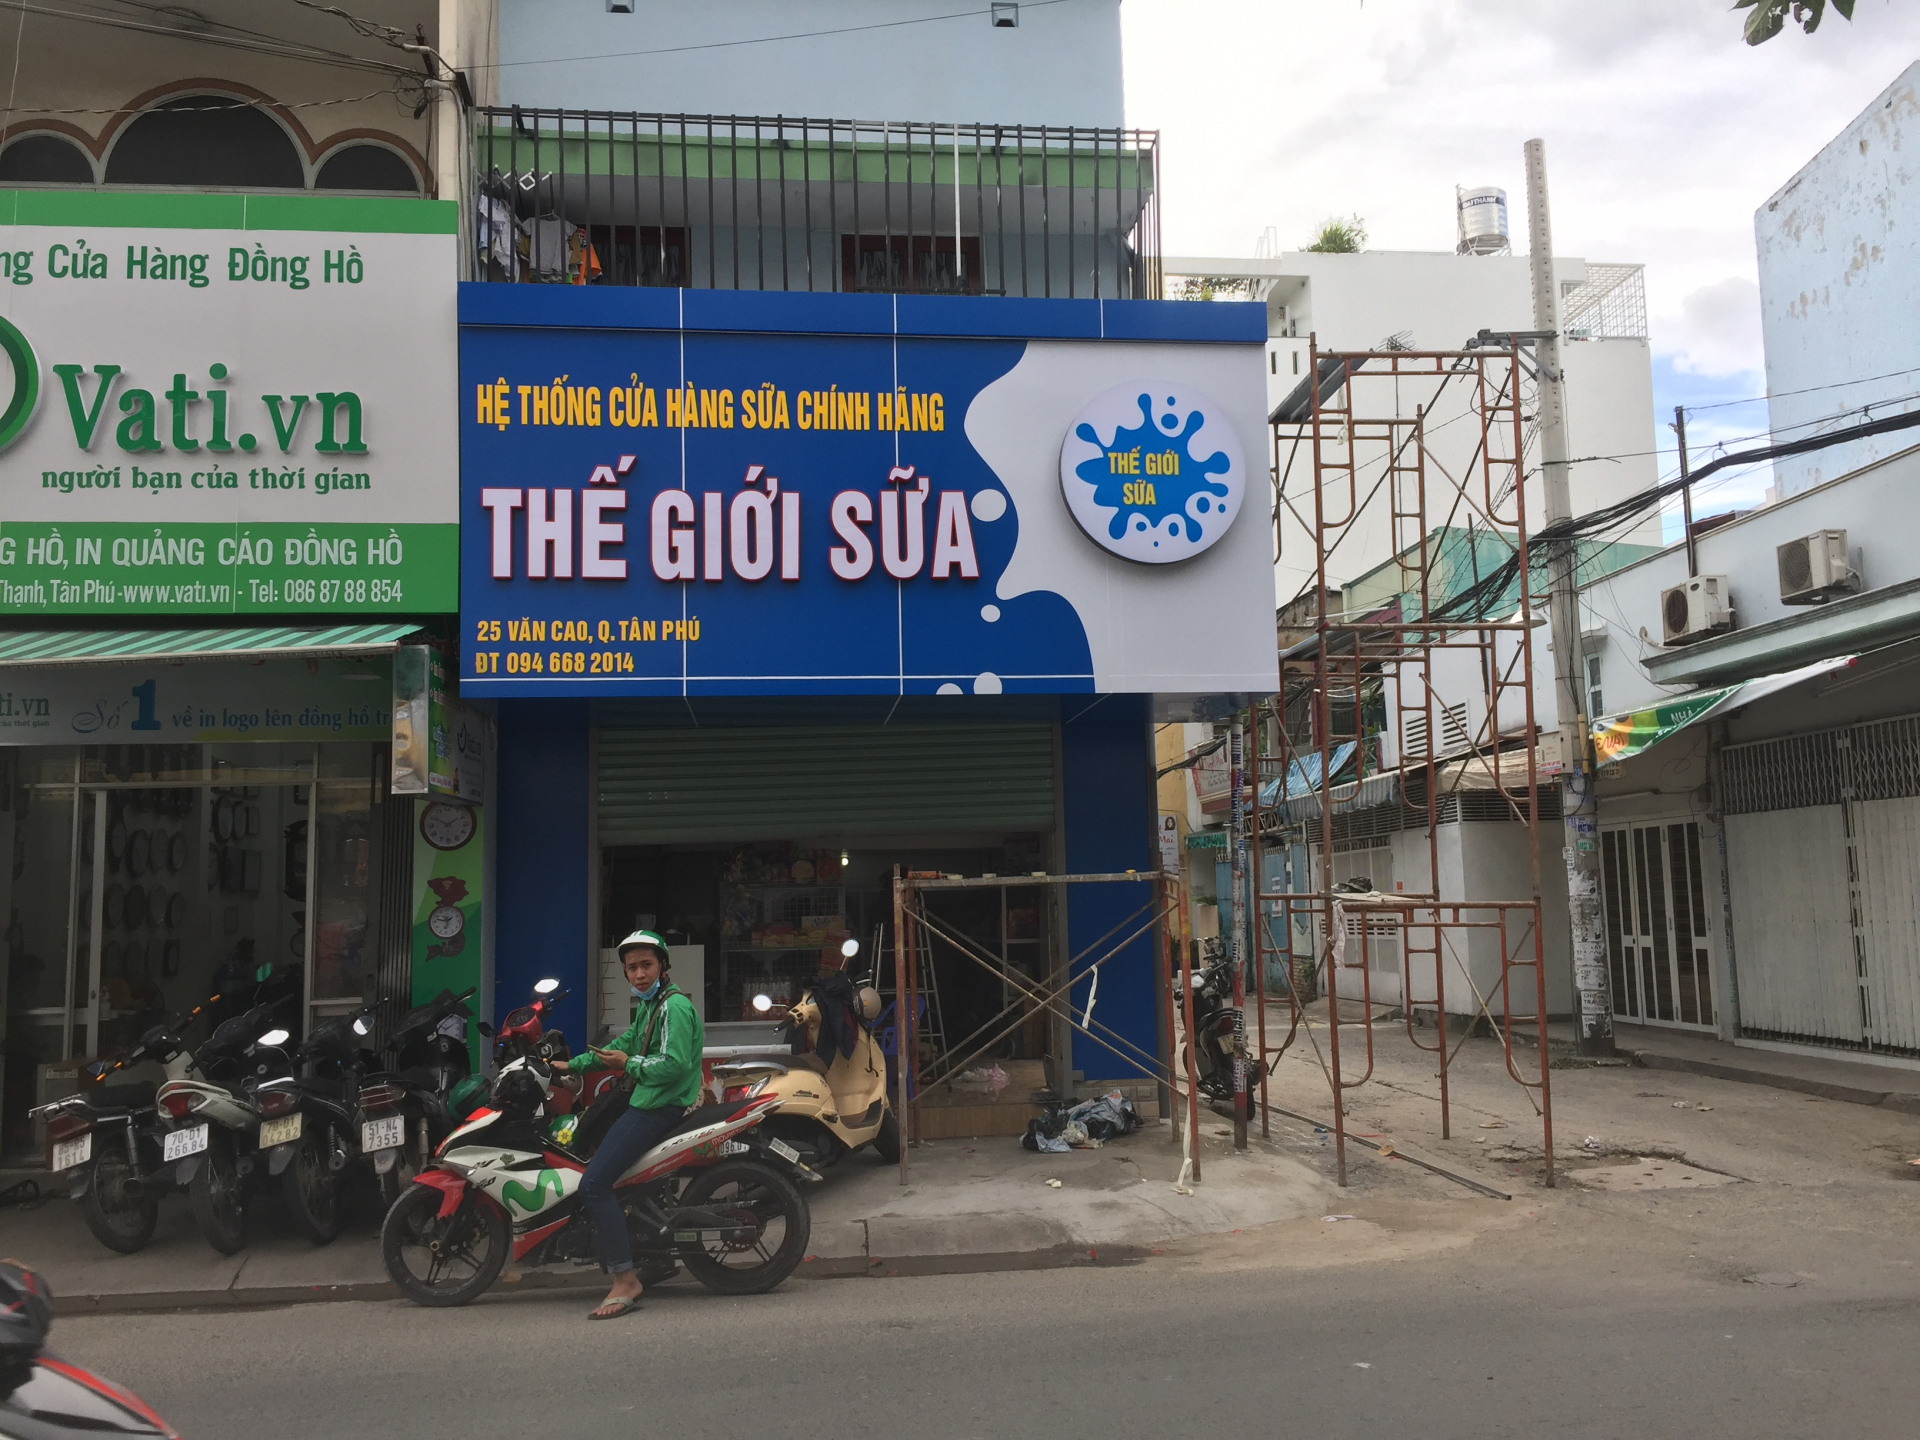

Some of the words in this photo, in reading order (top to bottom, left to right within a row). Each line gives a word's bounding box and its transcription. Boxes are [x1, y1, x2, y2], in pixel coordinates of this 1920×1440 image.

[48, 239, 108, 280] Cửa
[126, 245, 210, 288] Hàng
[228, 242, 311, 290] Đồng
[324, 245, 364, 284] Hồ
[52, 362, 369, 454] Vati.vn
[477, 378, 510, 432] HỆ
[518, 375, 601, 427] THỐNG
[609, 372, 658, 428] CỬA
[666, 381, 734, 430] HÀNG
[741, 382, 790, 430] SỮA
[796, 383, 871, 432] CHÍNH
[877, 382, 945, 432] HÃNG
[1108, 446, 1142, 475] THẾ
[1145, 449, 1180, 476] GIỚI
[41, 464, 121, 493] người
[132, 467, 182, 495] bạn
[191, 464, 239, 489] của
[249, 466, 306, 490] thời
[315, 468, 371, 495] gian
[1123, 479, 1156, 506] SỮA
[480, 454, 637, 582] THẾ
[650, 464, 802, 583] GIỚI
[828, 464, 981, 582] SỮA
[27, 528, 69, 570] HỒ,
[75, 538, 101, 565] IN
[112, 529, 204, 568] QUẢNG
[217, 531, 273, 566] CÁO
[284, 527, 357, 566] ĐỒNG
[367, 528, 403, 566] HỒ
[50, 580, 80, 603] Tân
[249, 580, 278, 602] Tel:
[284, 580, 315, 602] 086
[319, 580, 341, 602] 87
[344, 580, 366, 602] 88
[370, 580, 403, 602] 854
[477, 620, 500, 642] 25
[507, 617, 546, 642] VĂN
[551, 621, 594, 645] CAO,
[597, 621, 617, 644] Q.
[619, 617, 656, 642] TÂN
[661, 616, 700, 642] PHÚ
[475, 653, 499, 674] ĐT
[506, 653, 543, 674] 094
[549, 653, 585, 674] 668
[590, 653, 634, 674] 2014
[71, 699, 128, 734] Số
[131, 679, 161, 731] 1
[173, 706, 191, 728] về
[200, 708, 216, 728] in
[223, 708, 259, 733] logo
[265, 708, 292, 727] lên
[299, 704, 342, 732] đồng
[348, 705, 370, 727] hồ
[167, 1138, 205, 1159] 266.84
[172, 1128, 201, 1146] 70-D1
[369, 1133, 398, 1149] 7355
